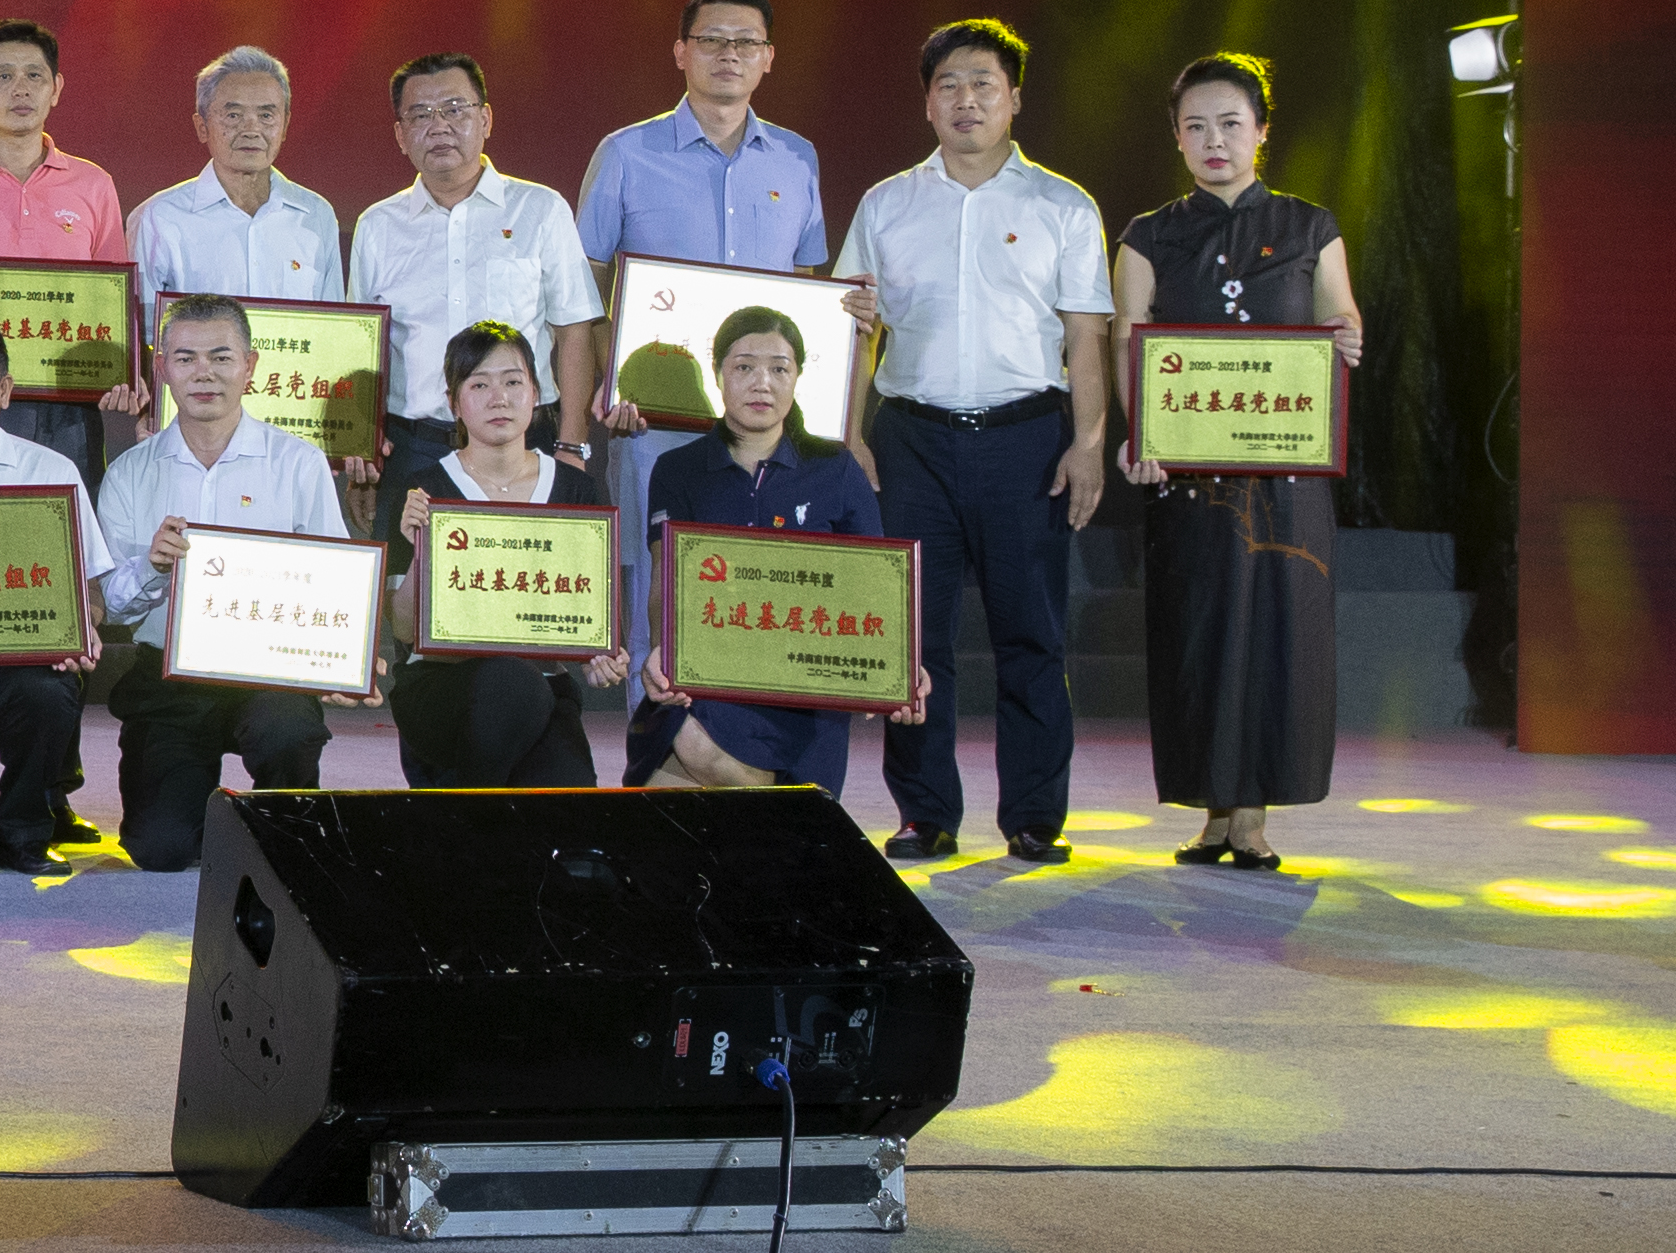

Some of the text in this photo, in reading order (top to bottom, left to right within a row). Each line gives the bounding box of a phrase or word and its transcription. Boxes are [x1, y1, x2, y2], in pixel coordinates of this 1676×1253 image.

[1, 290, 75, 304] 2020-2021学年度
[251, 338, 311, 354] 2021学年度
[1189, 360, 1273, 374] 2020-2021学年度
[242, 370, 354, 401] 层党组织
[1160, 388, 1314, 414] 先进基层党组织
[474, 537, 553, 552] 2020-2021学年度
[448, 565, 592, 595] 先进基层党组织
[734, 567, 835, 588] 2020-2021学年度
[202, 594, 349, 628] 先进基层党组织
[701, 596, 885, 637] 先进基层党组织
[787, 652, 886, 670] 中共海南师范大学委员会
[710, 1031, 729, 1075] NEXO
